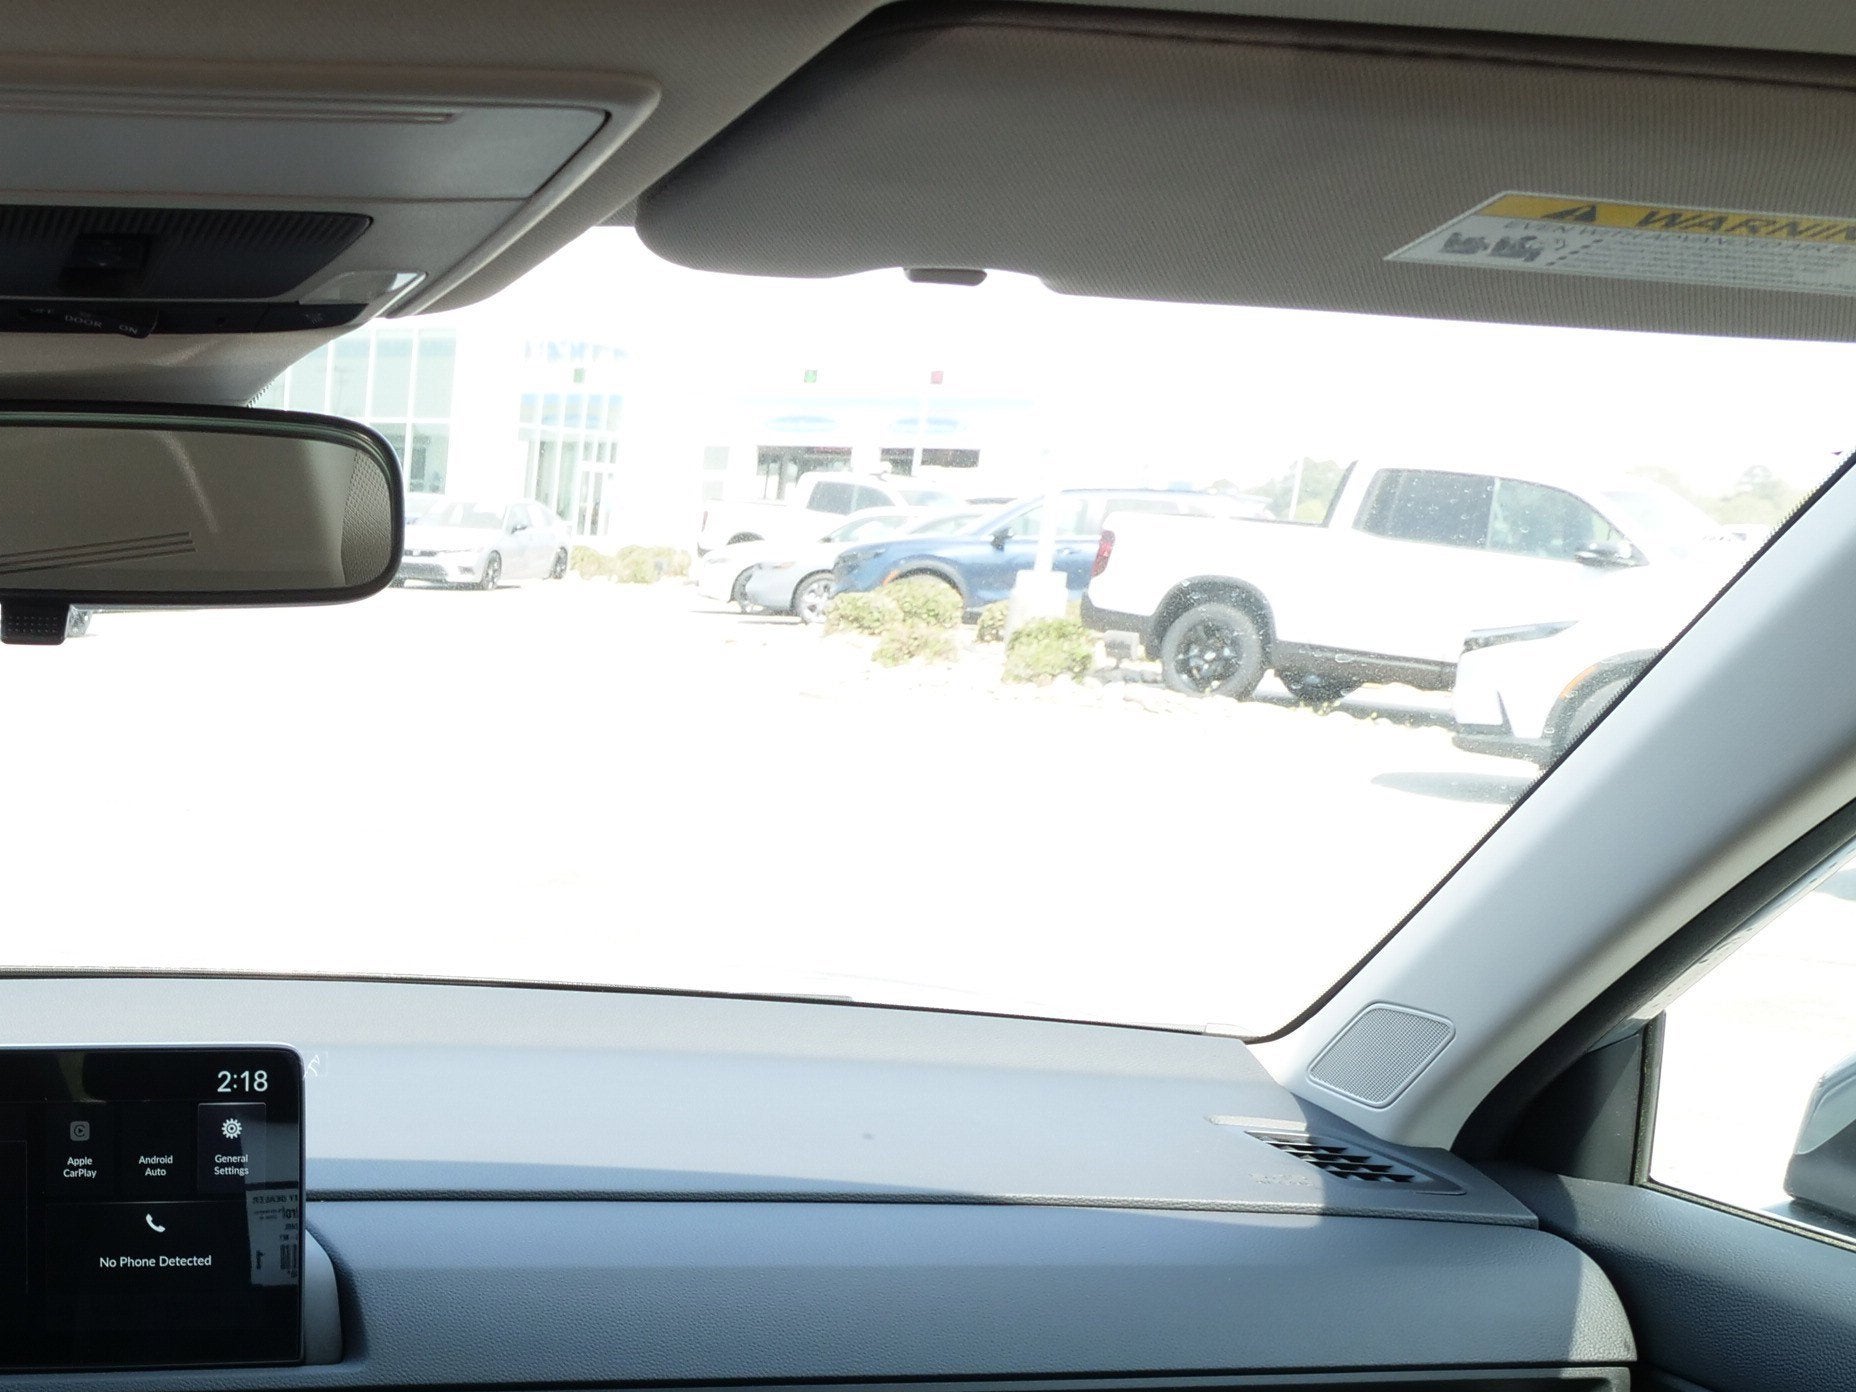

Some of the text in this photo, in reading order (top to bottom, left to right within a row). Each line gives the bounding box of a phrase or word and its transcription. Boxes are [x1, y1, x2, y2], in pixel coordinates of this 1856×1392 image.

[119, 324, 138, 335] ON
[217, 1070, 268, 1092] 2:18
[67, 1156, 93, 1167] Apple
[138, 1155, 173, 1165] Android
[214, 1154, 248, 1163] General
[63, 1168, 97, 1179] CarPlay
[145, 1167, 167, 1176] Auto
[214, 1166, 249, 1177] Settings
[99, 1255, 212, 1268] No Phone Detected
